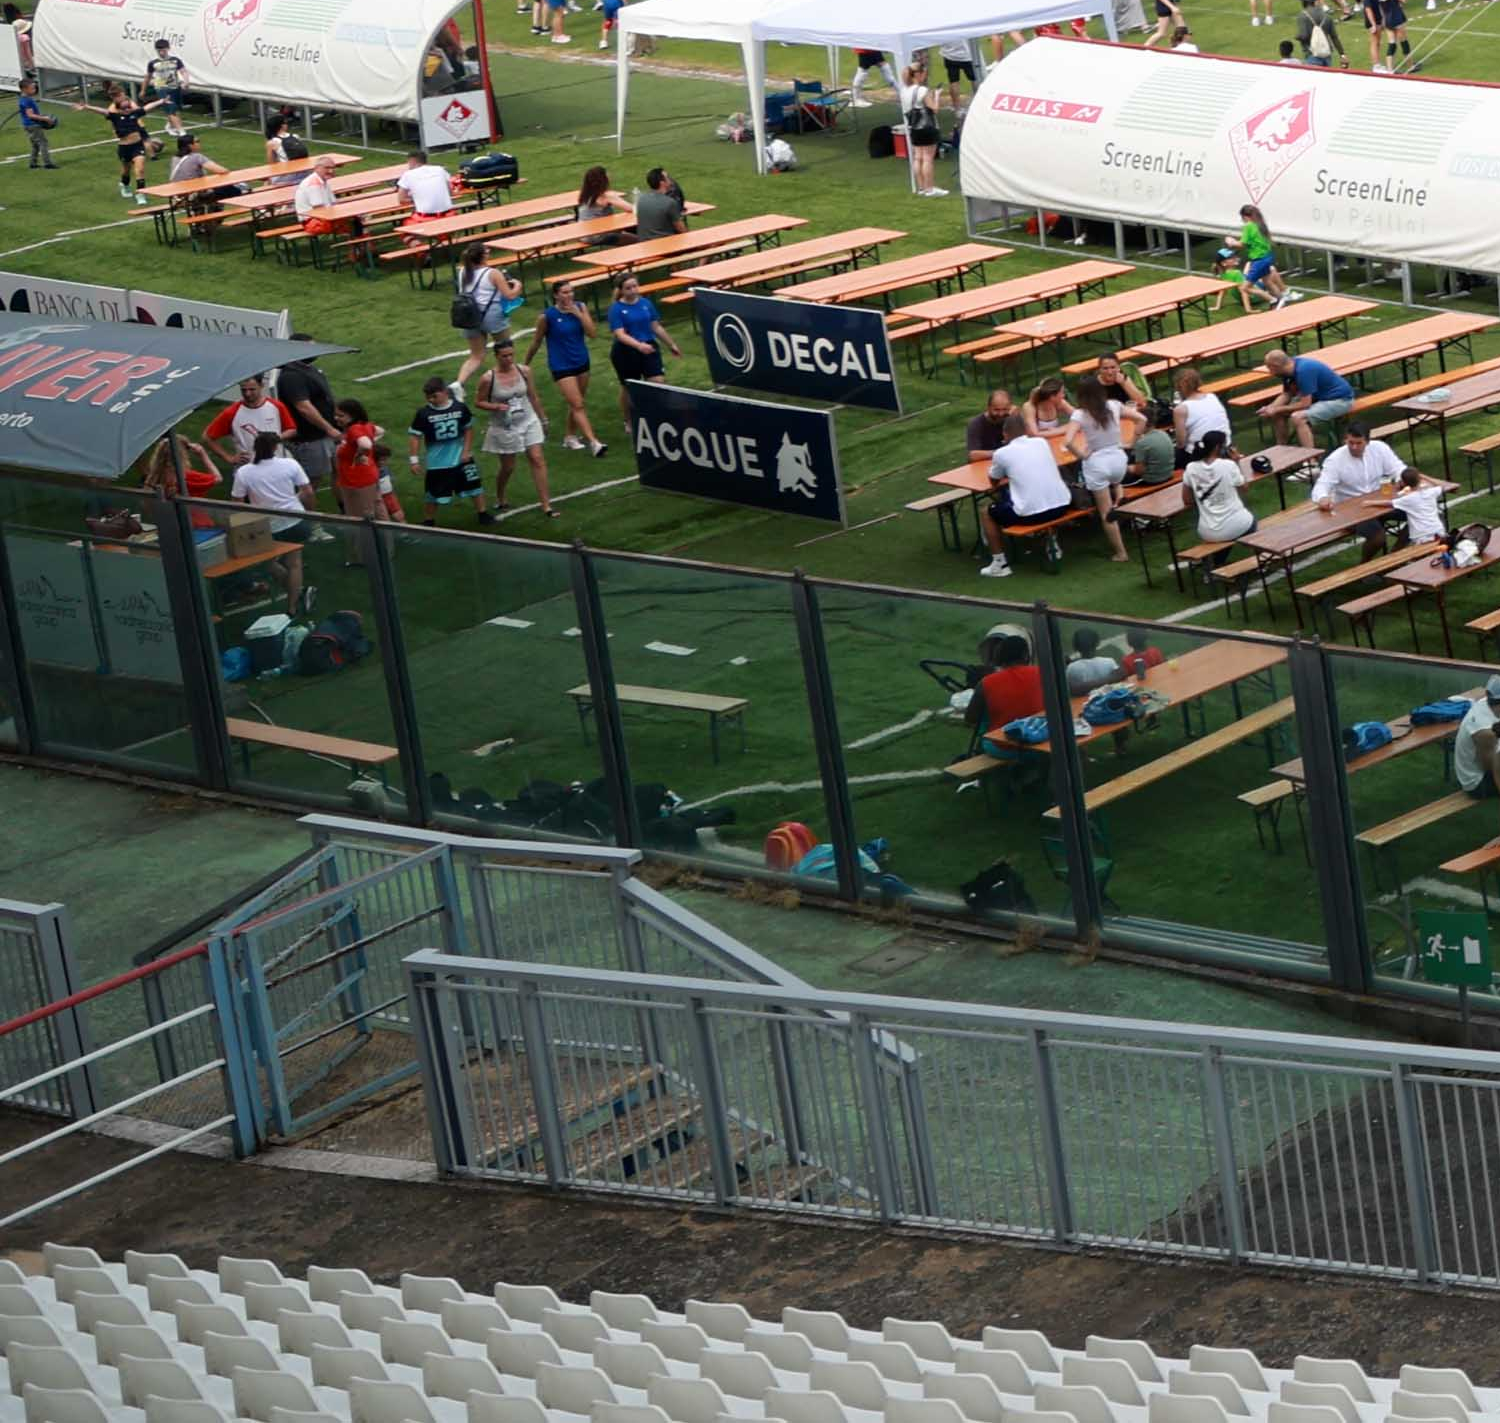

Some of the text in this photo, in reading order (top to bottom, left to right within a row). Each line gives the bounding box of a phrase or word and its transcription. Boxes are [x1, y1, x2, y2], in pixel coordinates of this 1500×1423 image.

[251, 37, 321, 64] ScreenLine
[995, 95, 1064, 117] ALIAS
[1101, 141, 1204, 178] ScreenLine
[1313, 169, 1427, 207] ScreenLine
[33, 290, 121, 322] BANCA DI
[767, 330, 892, 382] DECAL
[435, 420, 458, 439] 23
[636, 417, 765, 478] ACQUE
